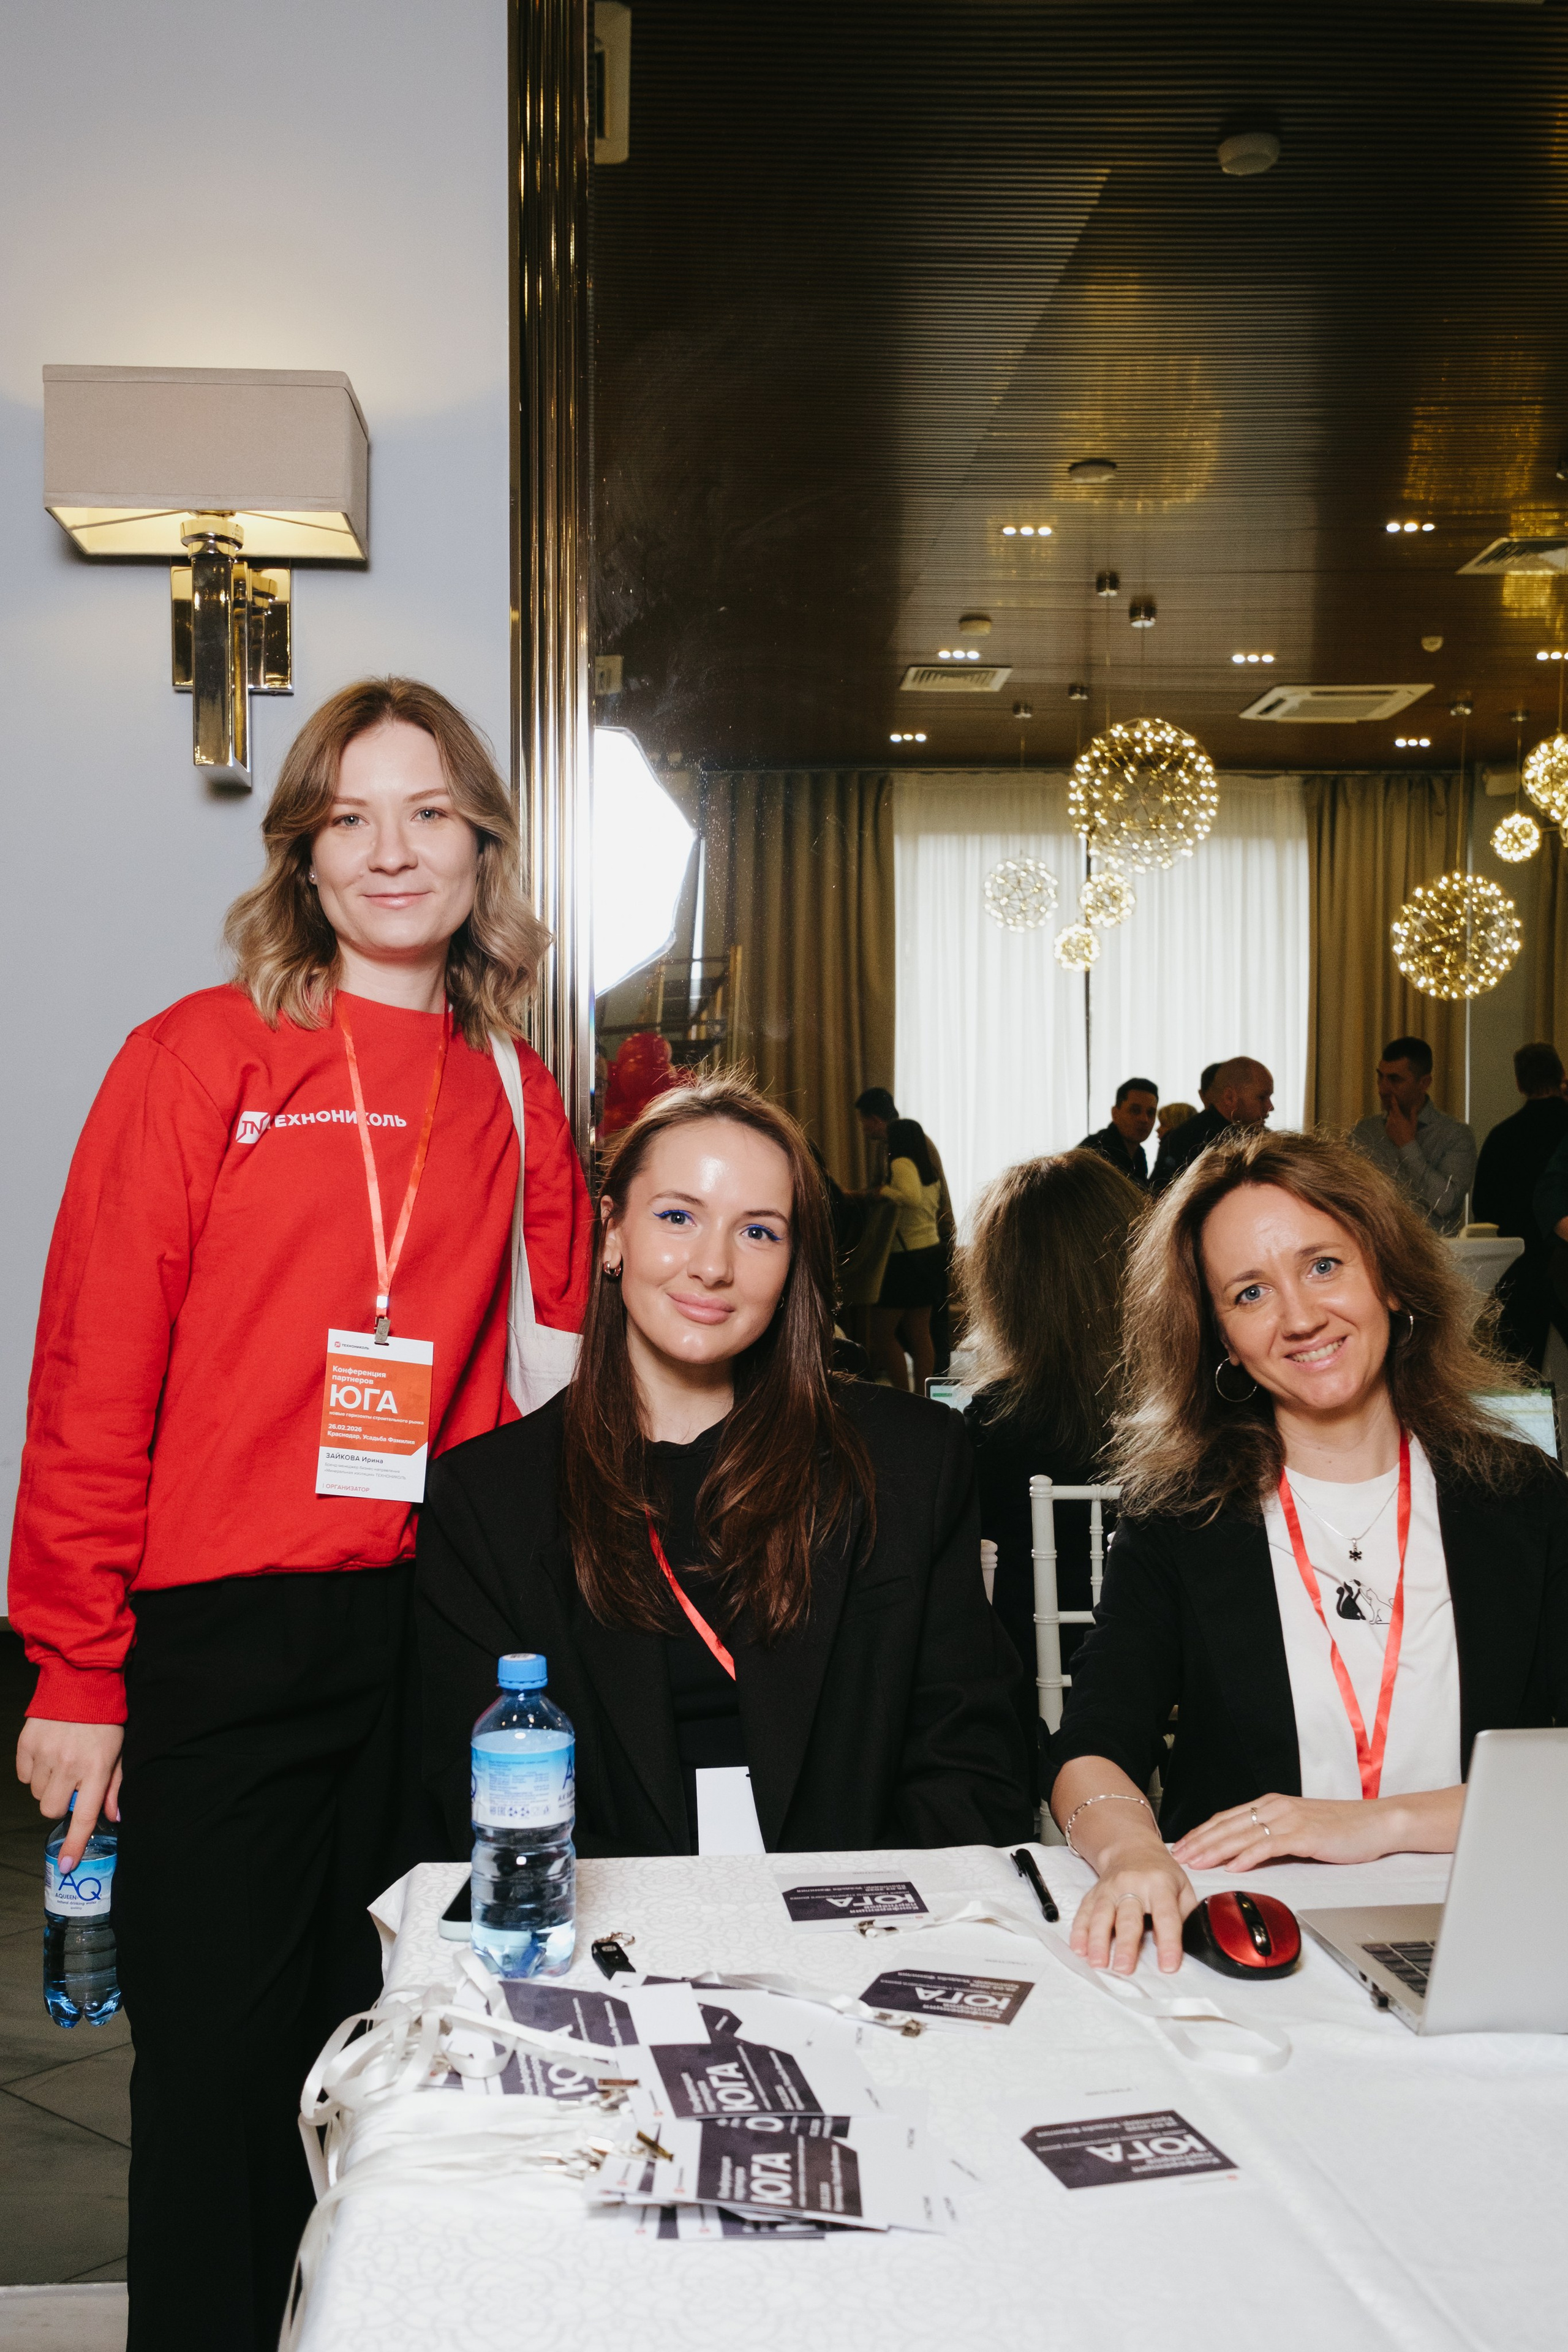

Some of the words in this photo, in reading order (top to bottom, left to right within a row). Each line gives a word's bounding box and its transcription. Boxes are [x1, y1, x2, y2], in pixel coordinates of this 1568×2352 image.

[333, 1365, 386, 1378] Конференция
[332, 1374, 374, 1384] партнеров
[330, 1384, 398, 1414] ЮГА
[328, 1423, 362, 1432] 26.02.2026
[327, 1430, 361, 1439] Краснодар,
[326, 1452, 360, 1461] ЗАЙКОВА
[326, 1483, 370, 1492] ОРГАНИЗАТОР
[58, 1872, 101, 1901] AQ
[825, 1894, 915, 1907] ЮГА
[915, 1987, 1011, 2010] ЮГА
[706, 2062, 760, 2111] ЮГА
[1085, 2134, 1208, 2162] ЮГА
[750, 2152, 793, 2205] ЮГА
